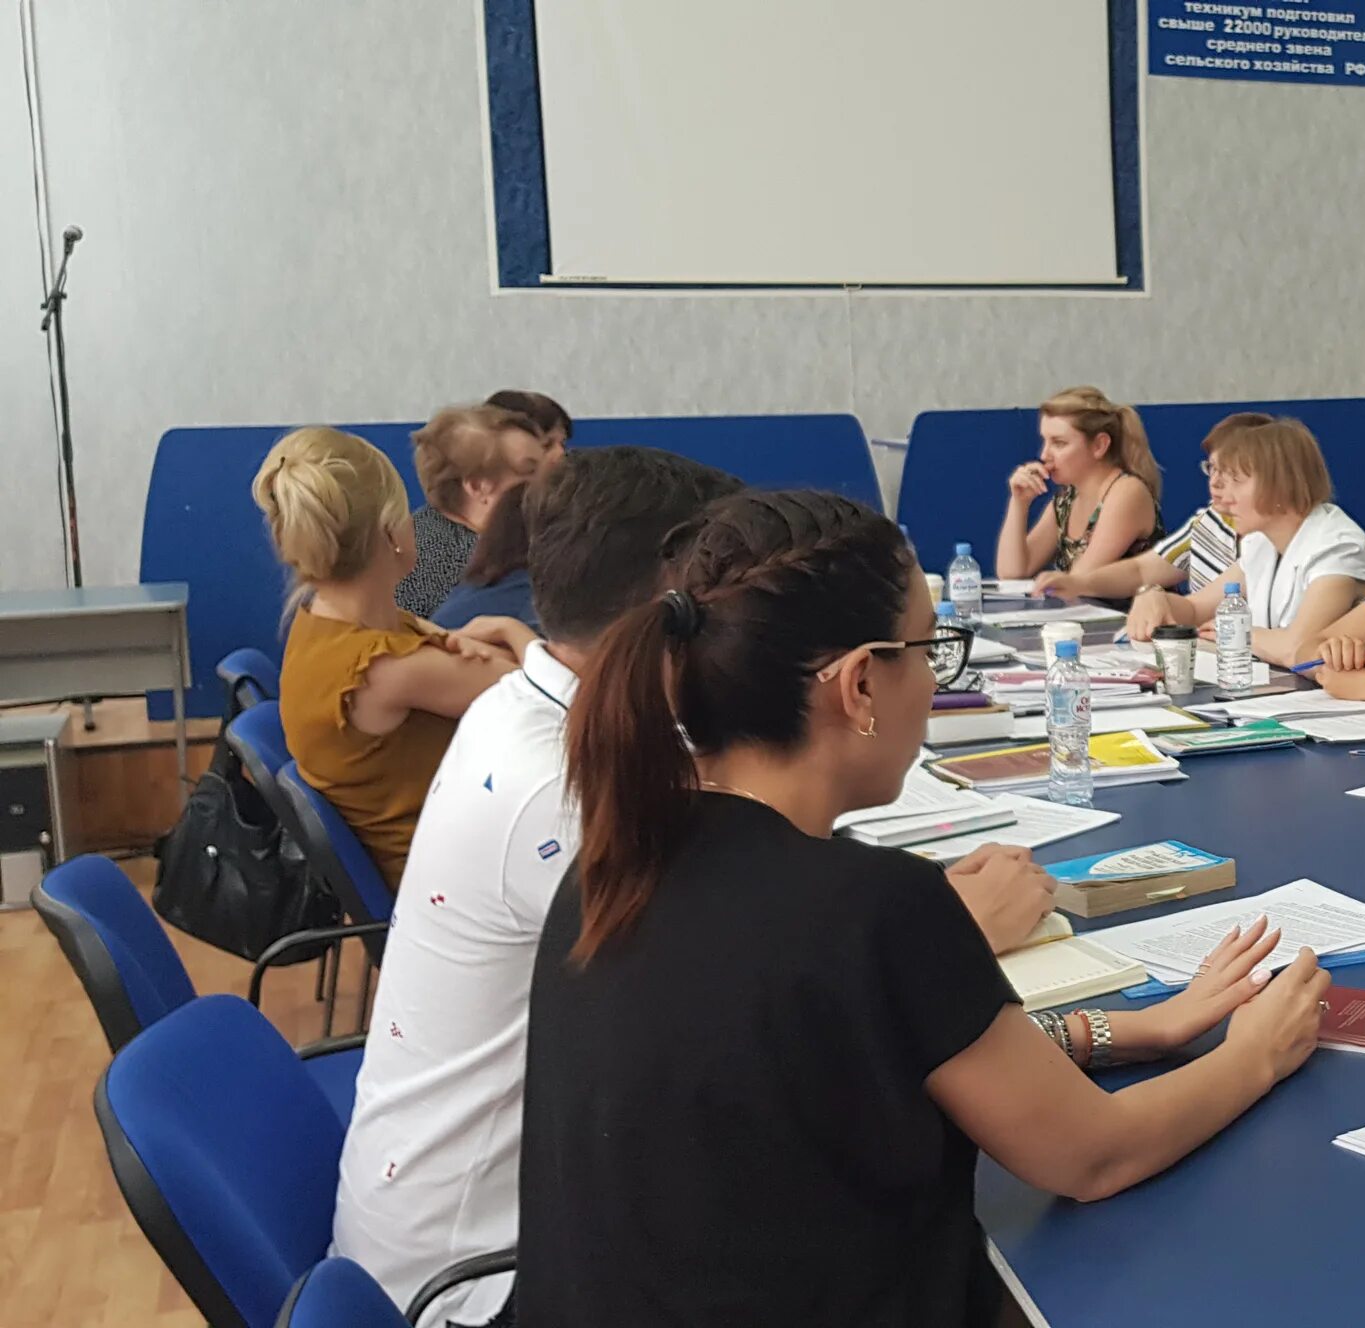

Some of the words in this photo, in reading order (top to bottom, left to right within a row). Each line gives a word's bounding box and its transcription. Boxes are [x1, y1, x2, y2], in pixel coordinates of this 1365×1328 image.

[1184, 2, 1262, 19] техникум
[1266, 8, 1355, 24] подготовил
[1158, 18, 1215, 31] свыше
[1223, 19, 1272, 35] 22000
[1206, 39, 1282, 53] среднего
[1286, 44, 1332, 56] звена
[1164, 55, 1250, 70] сельского
[1252, 60, 1335, 74] хозяйства
